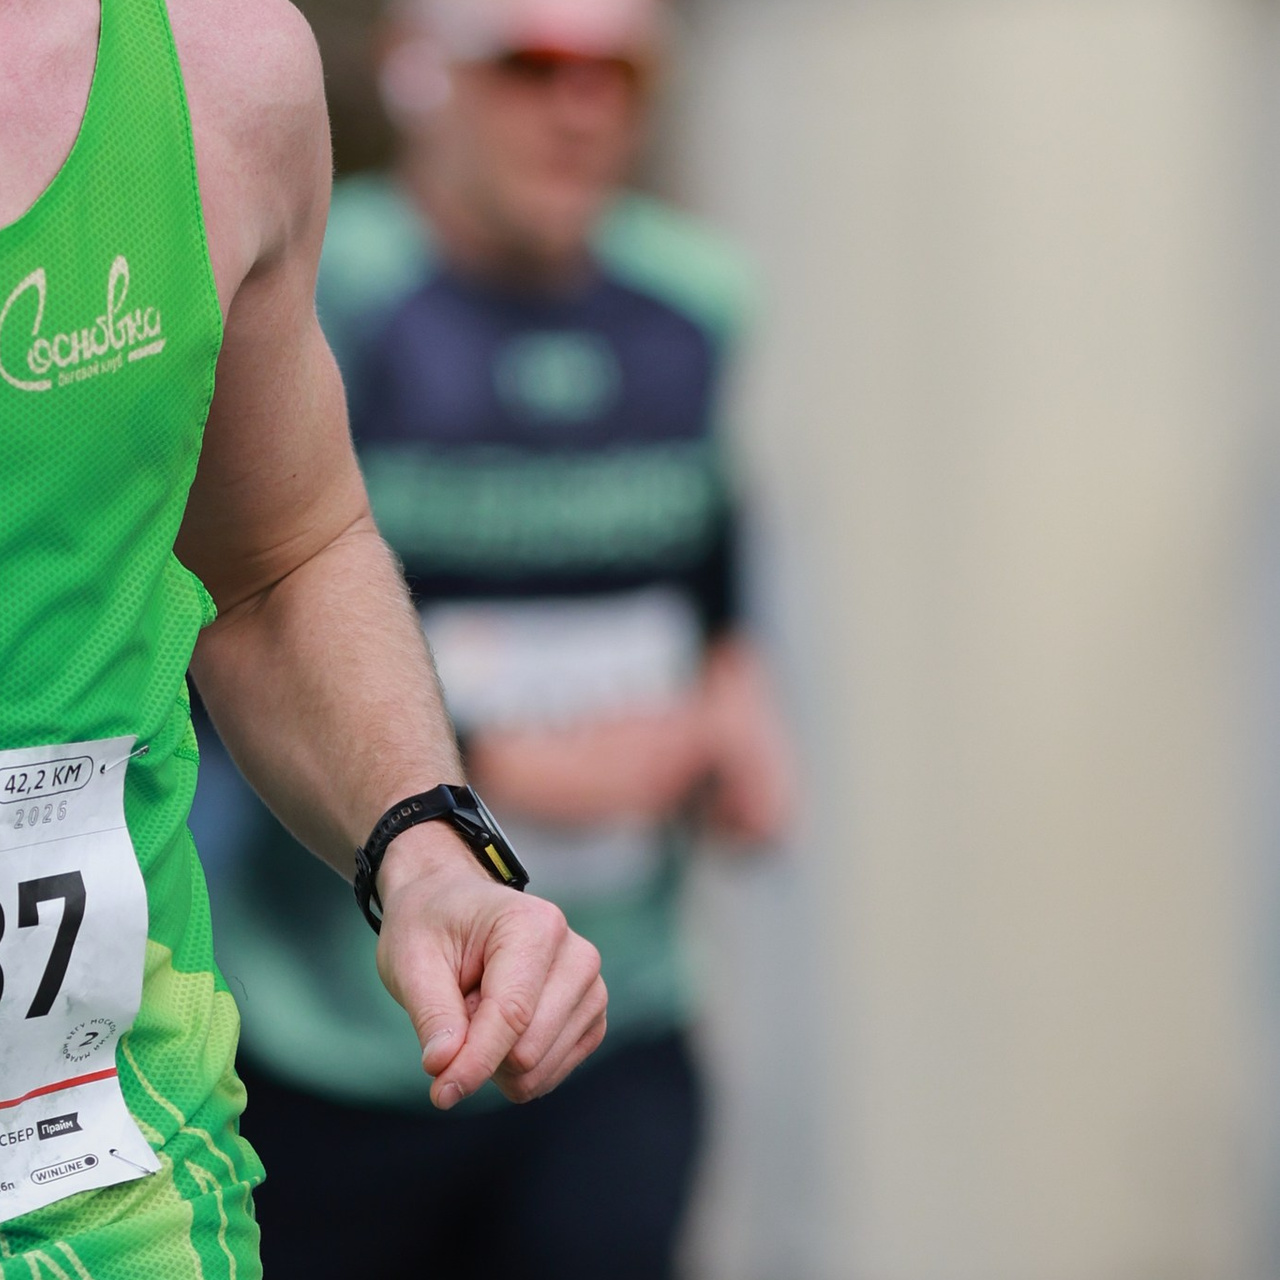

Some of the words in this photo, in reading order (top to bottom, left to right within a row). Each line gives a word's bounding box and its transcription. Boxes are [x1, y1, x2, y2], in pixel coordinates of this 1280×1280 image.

[4, 770, 45, 794] 42,2
[79, 1031, 99, 1048] 2
[40, 1119, 75, 1136] Прайм
[35, 1160, 84, 1183] WINLINE
